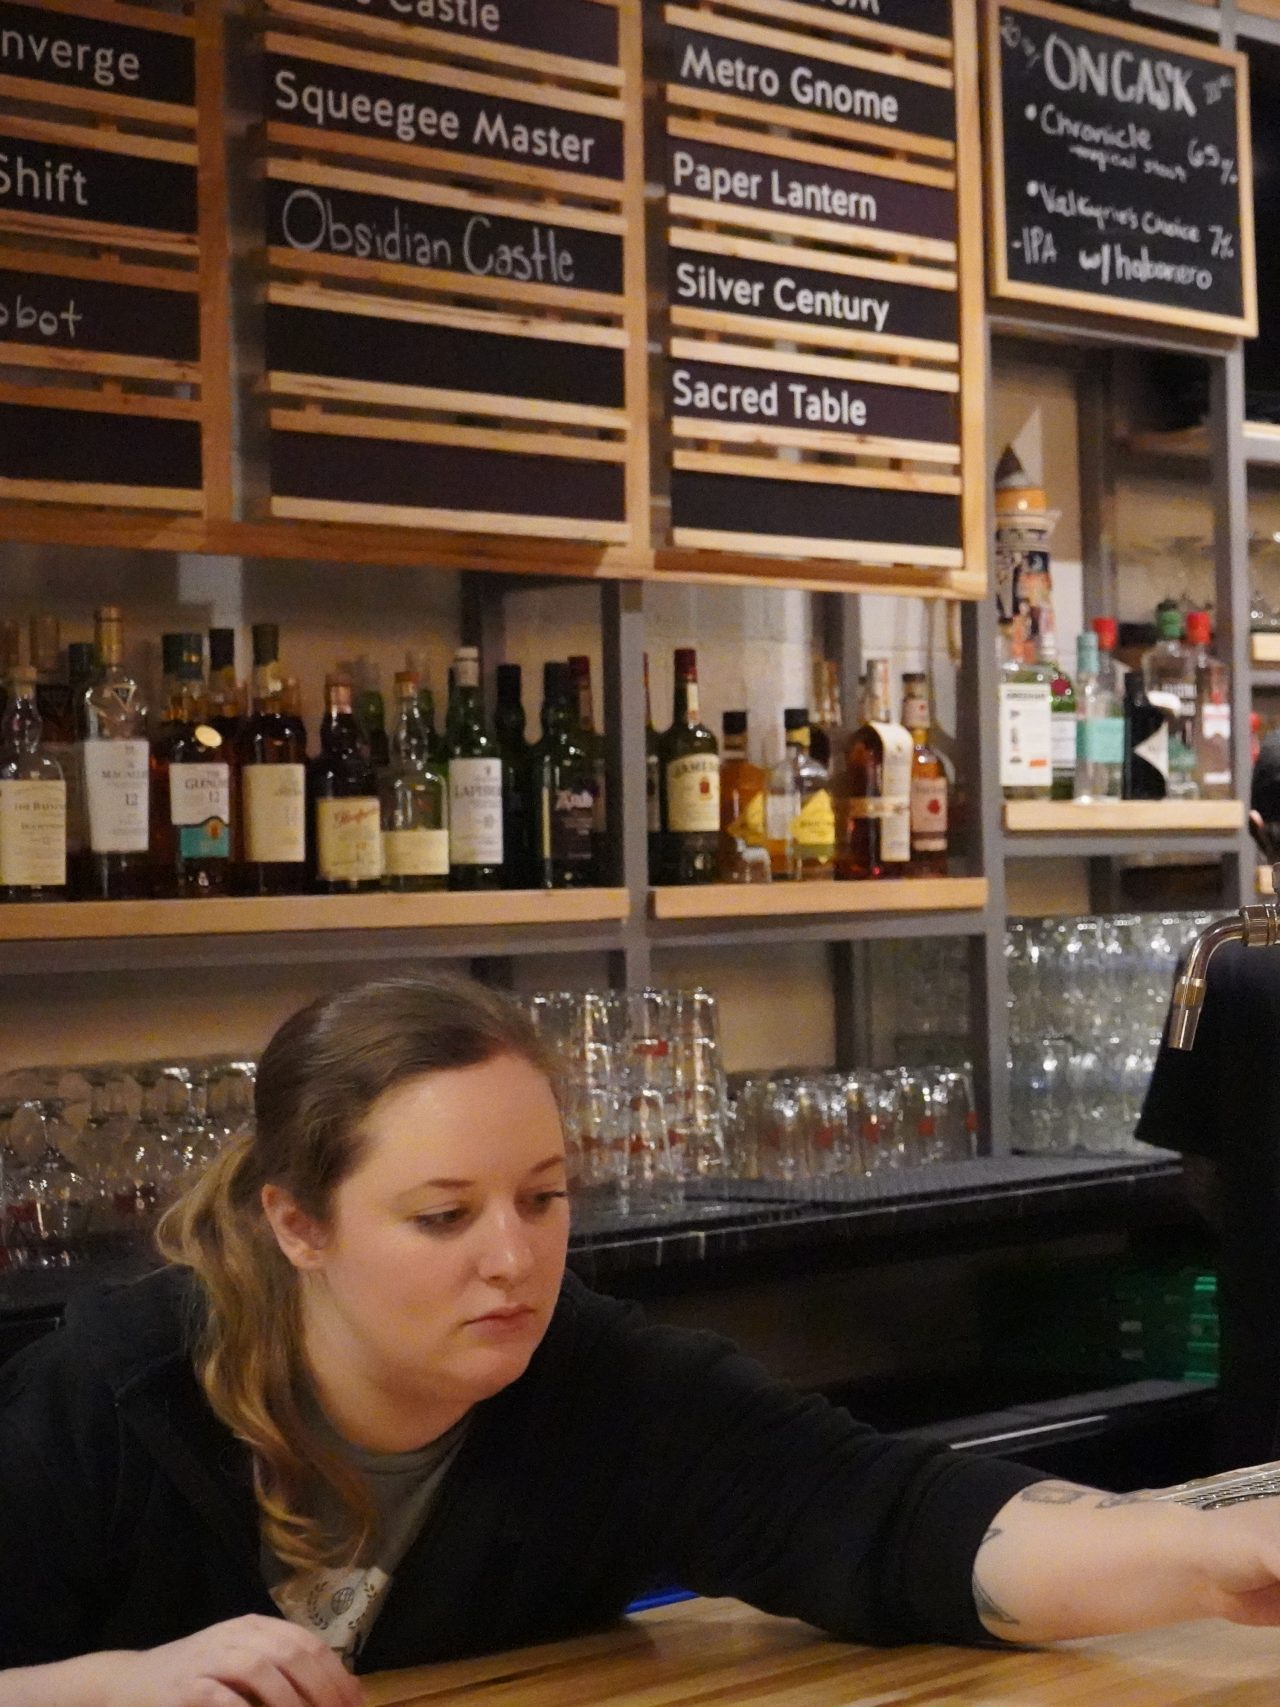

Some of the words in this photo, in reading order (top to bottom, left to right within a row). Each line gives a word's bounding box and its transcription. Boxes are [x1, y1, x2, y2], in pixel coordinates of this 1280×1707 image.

[276, 70, 460, 142] Squeegee
[473, 110, 595, 164] Master
[680, 44, 780, 97] Metro
[790, 66, 899, 123] Gnome
[673, 151, 760, 201] Paper
[772, 170, 877, 222] Lantern
[282, 188, 453, 267] Obsidian
[463, 215, 575, 283] Castle
[676, 262, 765, 308] Silver
[773, 277, 890, 332] Century
[672, 369, 778, 417] Sacred
[788, 383, 867, 427] Table
